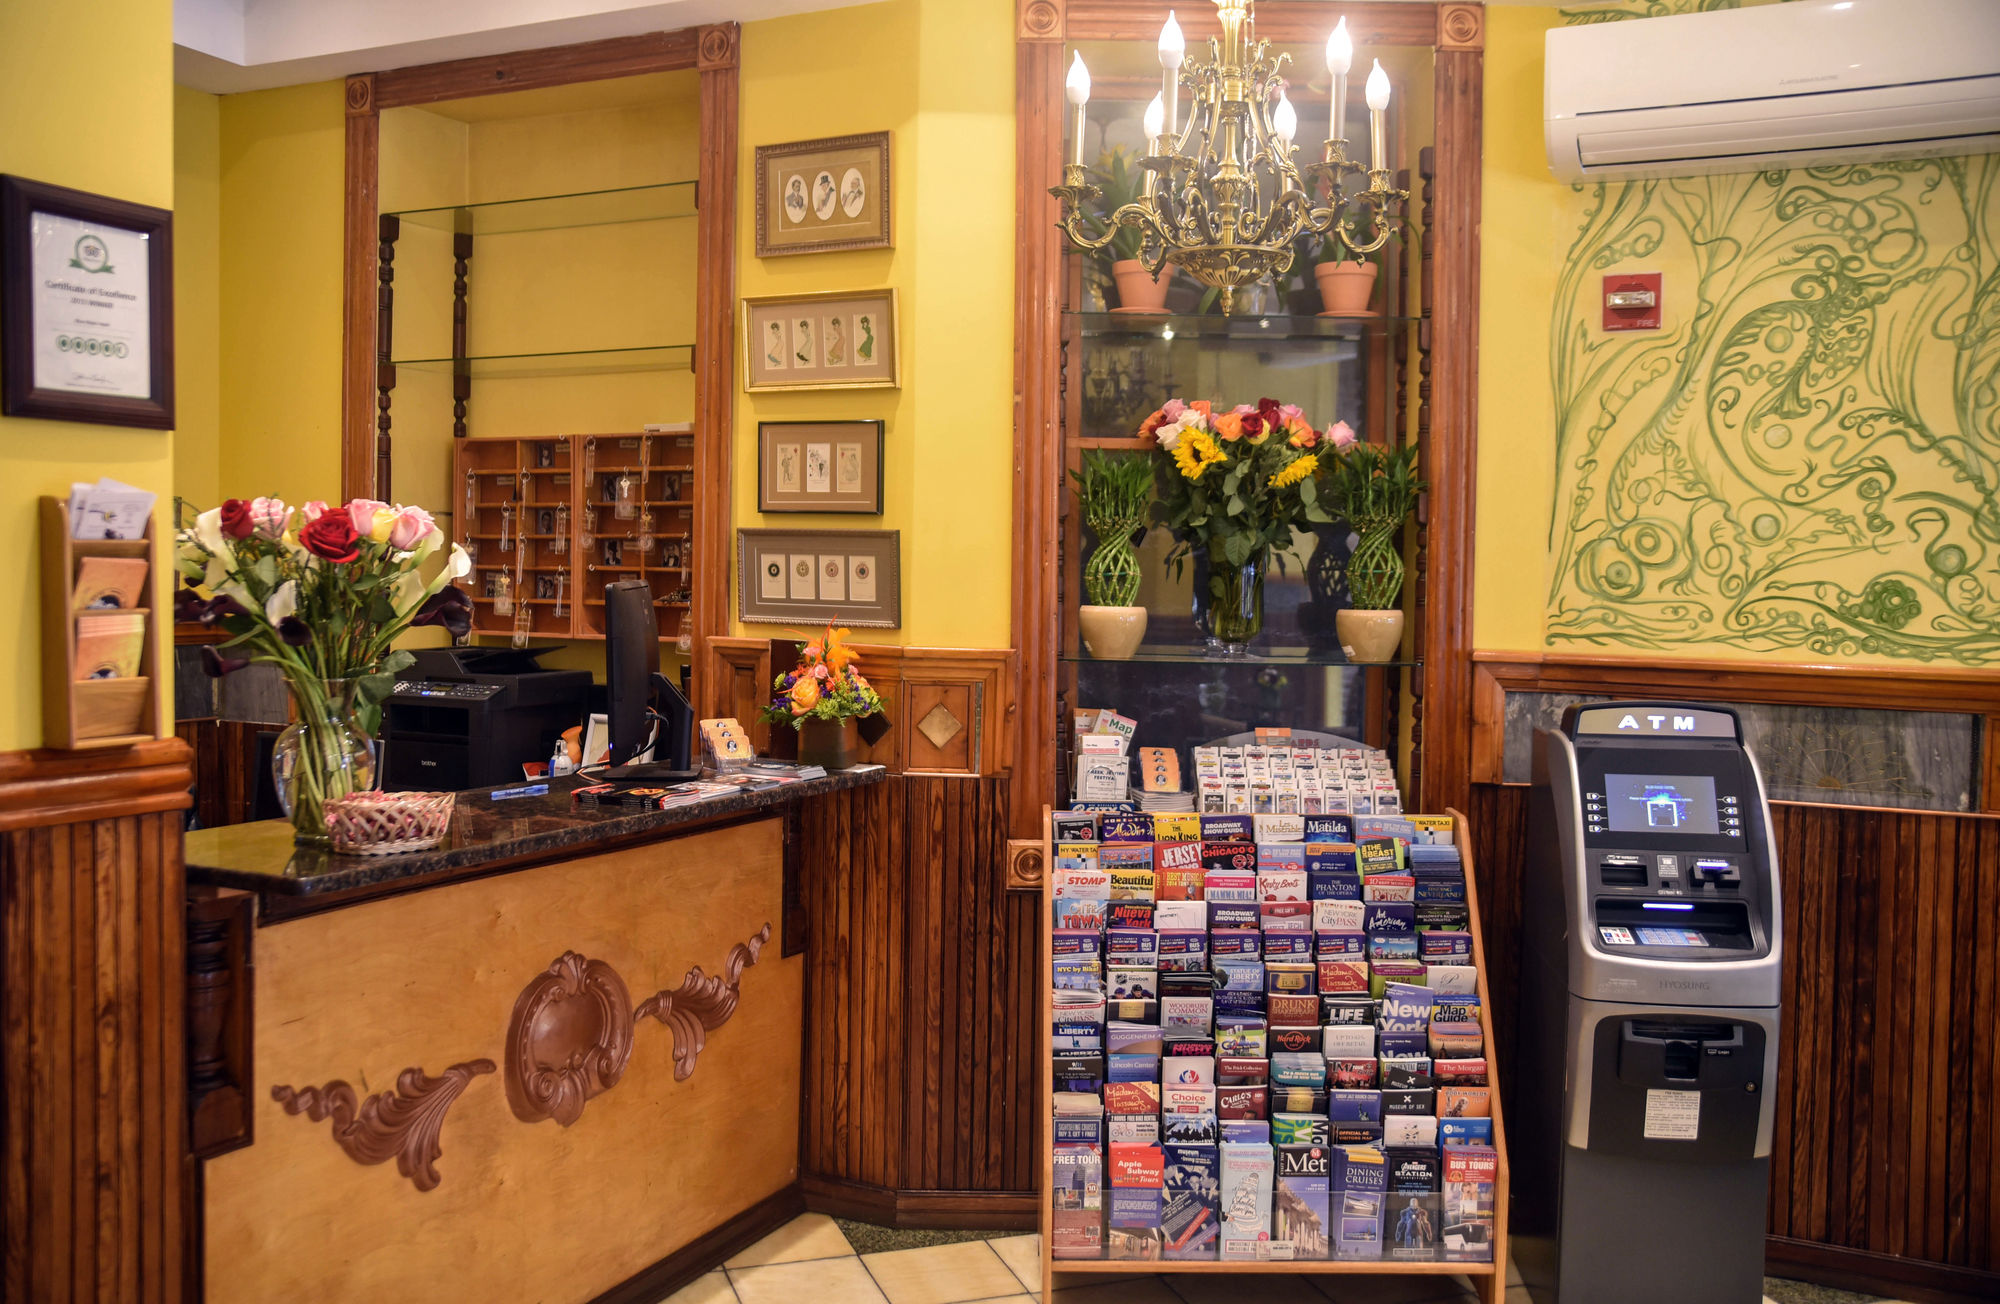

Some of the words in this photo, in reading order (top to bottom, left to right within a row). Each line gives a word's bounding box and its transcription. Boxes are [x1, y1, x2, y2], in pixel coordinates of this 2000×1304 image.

[1108, 718, 1133, 735] Map
[1618, 714, 1696, 731] ATM
[1290, 738, 1319, 748] ARDS
[1104, 822, 1146, 838] Aladdin
[1307, 820, 1347, 833] Matilda
[1178, 832, 1198, 841] KING
[1161, 842, 1202, 868] JERSEY
[1202, 846, 1246, 858] CHICAGO
[1368, 849, 1394, 858] BEAST
[1068, 877, 1106, 886] STOMP
[1111, 875, 1154, 886] Beautiful
[1280, 878, 1299, 888] Boots
[1316, 884, 1356, 892] PHANTOM
[1210, 890, 1236, 900] MAMMA
[1237, 890, 1252, 900] MIA!
[1114, 906, 1152, 918] Nueva
[1063, 914, 1103, 928] TOWN
[1125, 918, 1152, 928] York
[1321, 917, 1357, 927] CityPASS
[1368, 917, 1407, 930] American
[1321, 966, 1354, 976] Madame
[1320, 976, 1358, 990] Tussauds
[1659, 980, 1710, 990] HYOSUNG
[1272, 999, 1315, 1008] DRUNK
[1330, 1008, 1364, 1020] LIFE
[1382, 1000, 1430, 1018] New
[1440, 1004, 1466, 1018] Map
[1468, 1004, 1478, 1018] &
[1434, 1012, 1468, 1022] Guide
[1380, 1018, 1426, 1032] York
[1294, 1035, 1311, 1043] Rock
[1390, 1080, 1408, 1088] MUSEUM
[1106, 1085, 1140, 1097] Madame
[1108, 1096, 1146, 1111] Tussauds
[1220, 1092, 1252, 1108] CARLO'S
[1054, 1155, 1076, 1164] FREE
[1078, 1155, 1100, 1164] TOUR
[1285, 1152, 1327, 1172] Met
[1450, 1161, 1466, 1170] BUS
[1468, 1161, 1494, 1170] TOURS
[1126, 1168, 1160, 1176] Subway
[1347, 1168, 1384, 1177] DINING
[1346, 1176, 1383, 1185] CRUISES
